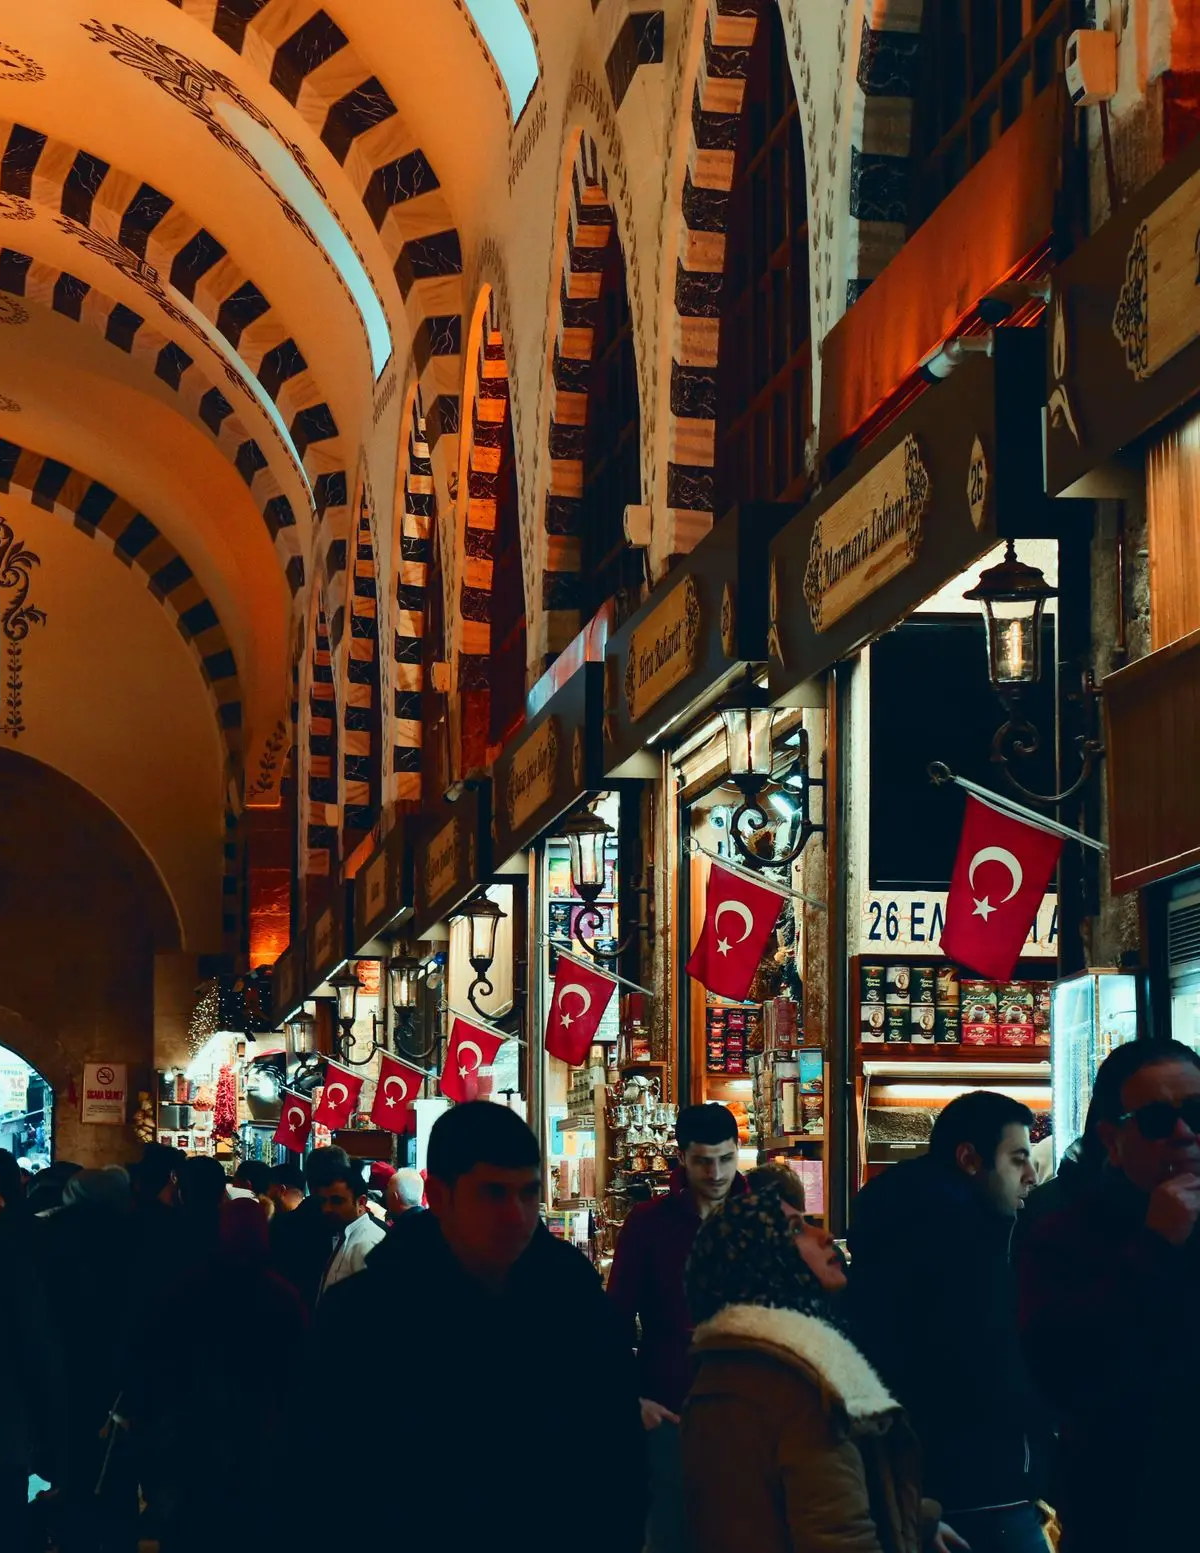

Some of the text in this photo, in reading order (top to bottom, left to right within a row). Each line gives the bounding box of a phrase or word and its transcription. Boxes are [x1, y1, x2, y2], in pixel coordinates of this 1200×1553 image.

[969, 459, 984, 506] 26
[822, 491, 906, 593] Marmara Lokum
[654, 619, 681, 674] Baharat
[869, 901, 899, 941] 26
